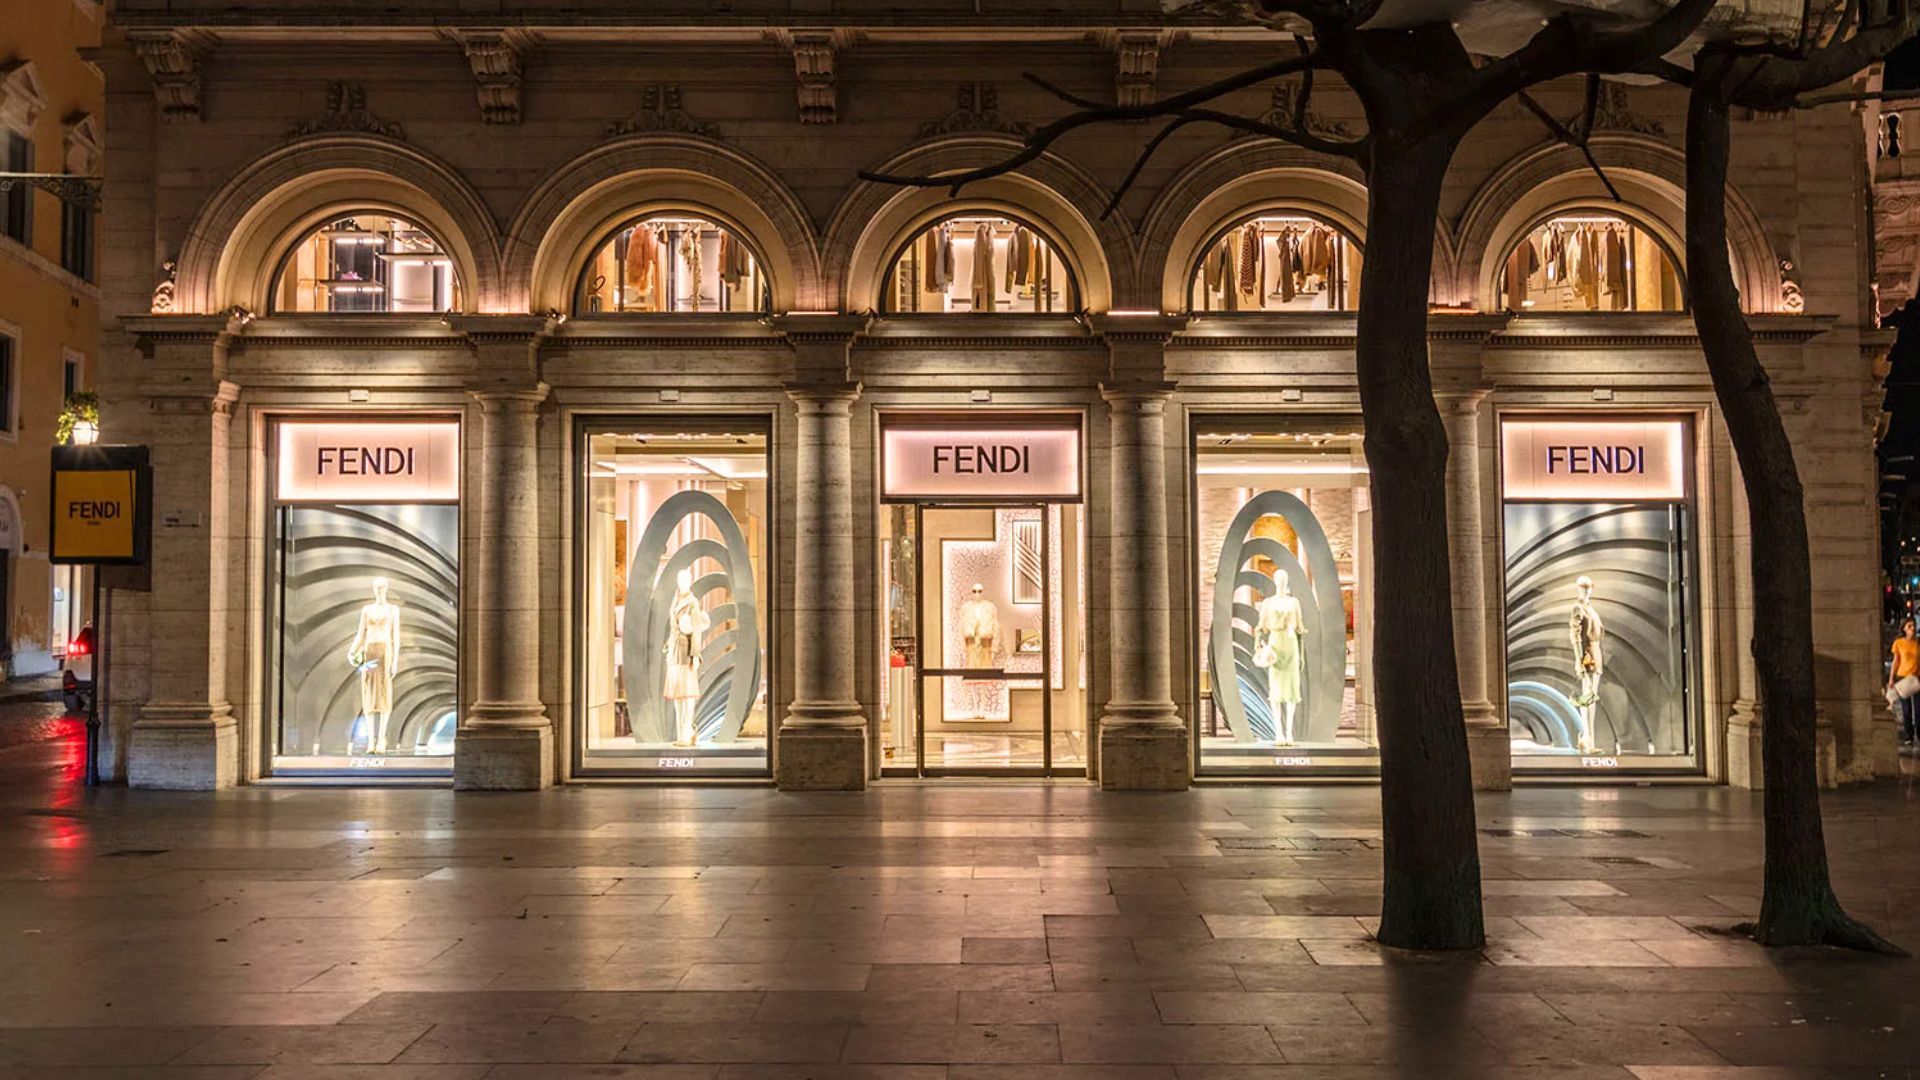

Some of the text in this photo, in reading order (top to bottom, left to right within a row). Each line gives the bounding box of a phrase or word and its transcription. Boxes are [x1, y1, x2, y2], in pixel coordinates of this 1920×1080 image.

[318, 447, 413, 475] FENDI
[933, 446, 1029, 473] FENDI
[1548, 446, 1644, 474] FENDI
[69, 501, 121, 519] FENDI
[658, 757, 694, 768] FENDI
